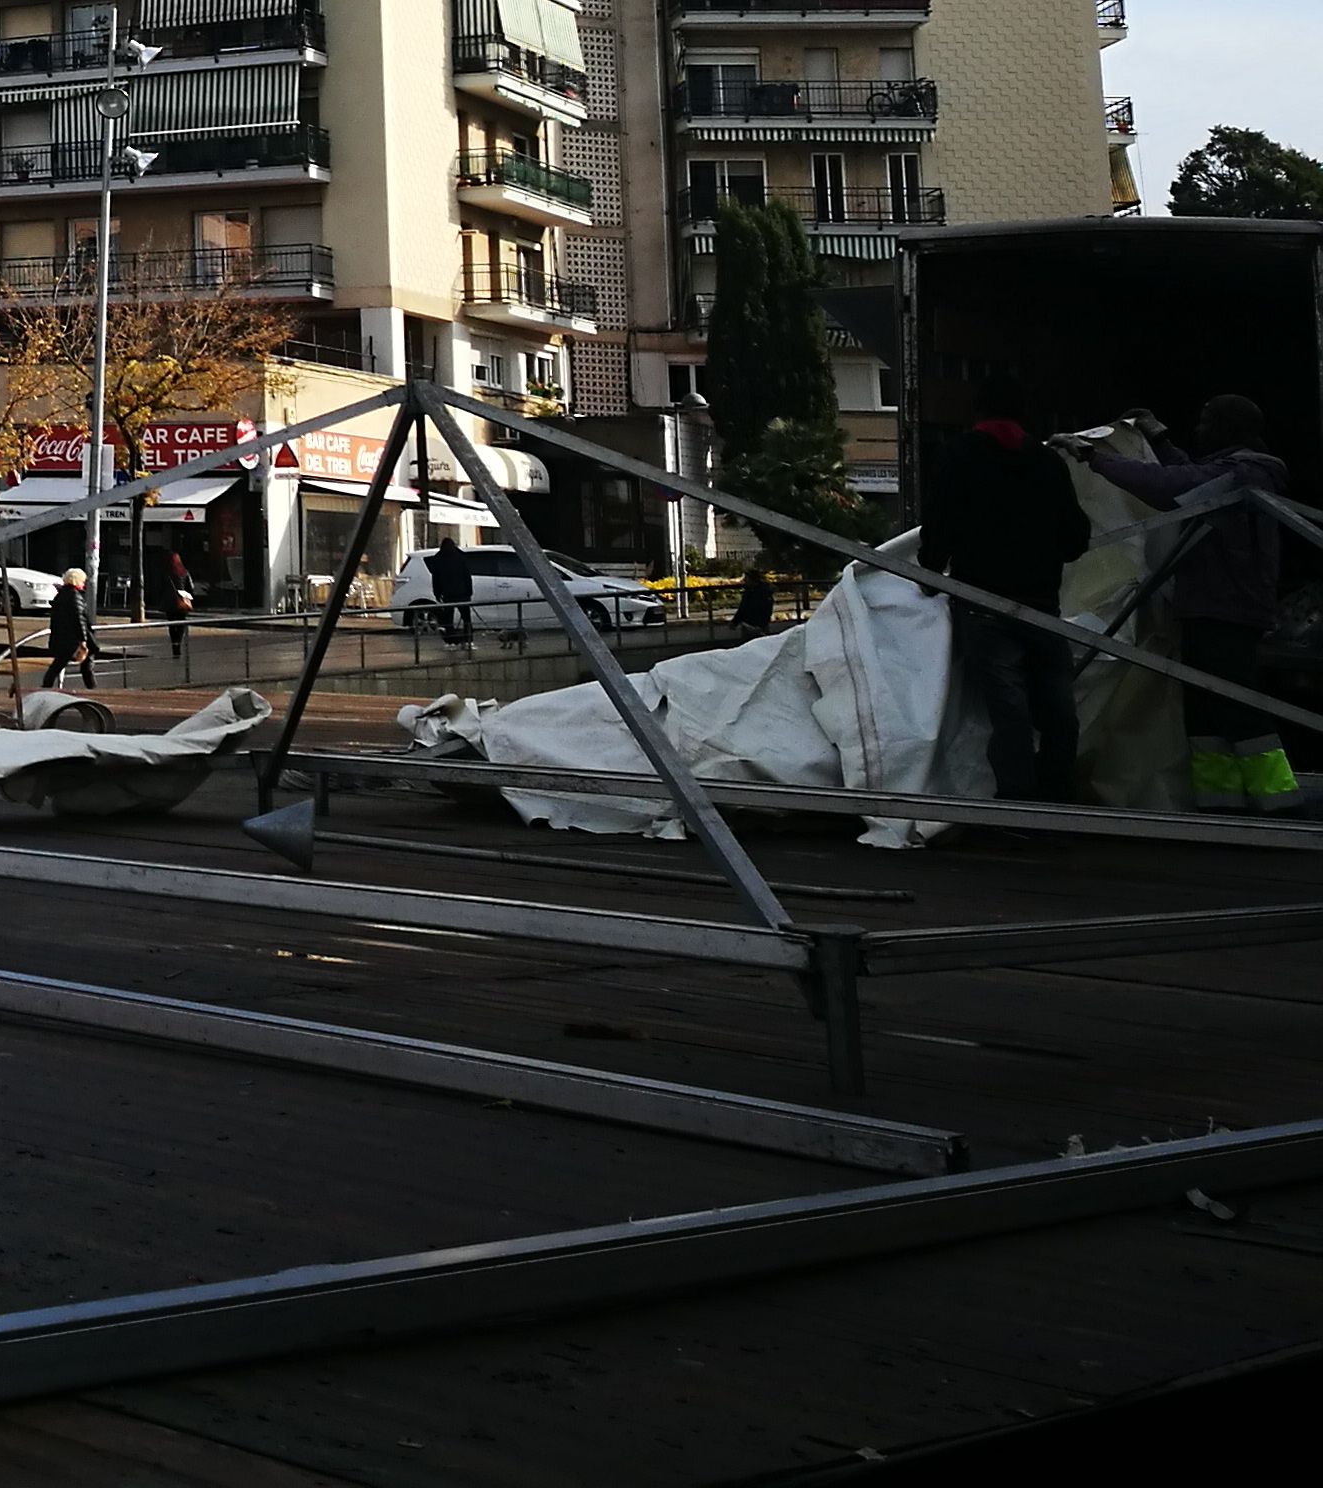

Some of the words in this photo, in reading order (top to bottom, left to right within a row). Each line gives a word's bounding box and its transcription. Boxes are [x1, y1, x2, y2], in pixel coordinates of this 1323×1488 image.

[142, 428, 168, 443] AR
[175, 428, 228, 444] CAFE
[143, 449, 167, 466] EL
[173, 449, 230, 466] TR
[105, 510, 126, 518] TREN
